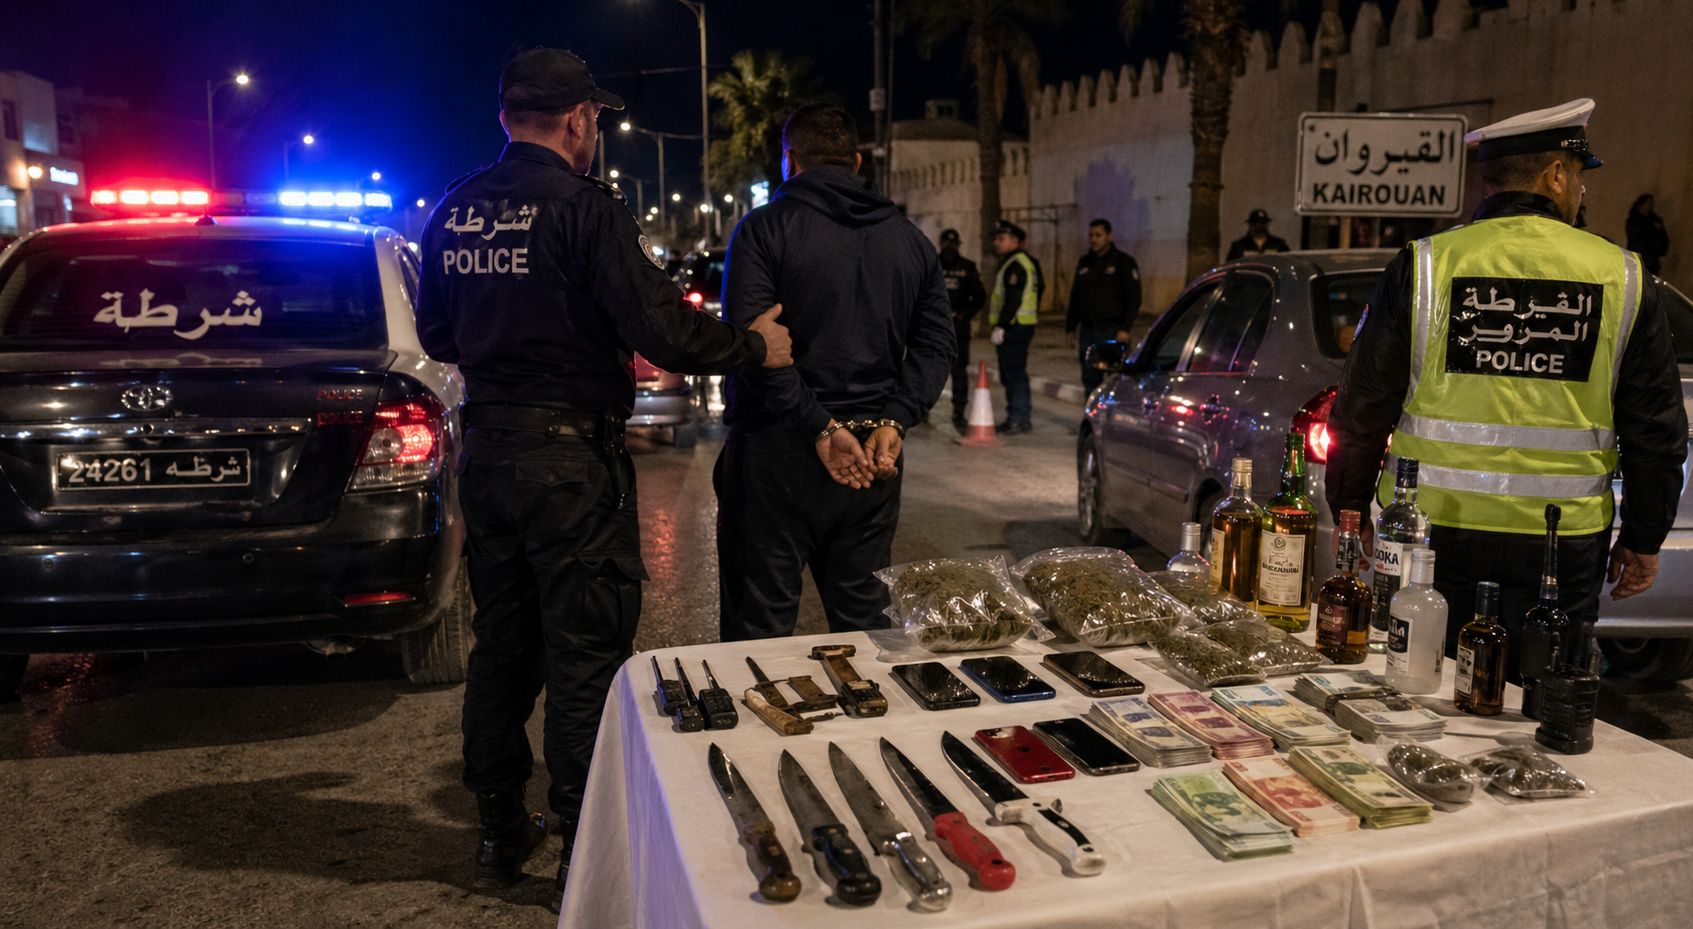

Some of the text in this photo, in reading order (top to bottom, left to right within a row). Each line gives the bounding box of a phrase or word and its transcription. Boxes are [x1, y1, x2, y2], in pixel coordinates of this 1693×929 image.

[1315, 128, 1456, 175] القيروان
[1313, 182, 1446, 206] KAIROUAN
[444, 204, 533, 241] شرطة
[442, 247, 530, 275] POLICE
[93, 287, 263, 341] شرطة
[1475, 350, 1566, 375] POLICE
[68, 457, 151, 484] 24261
